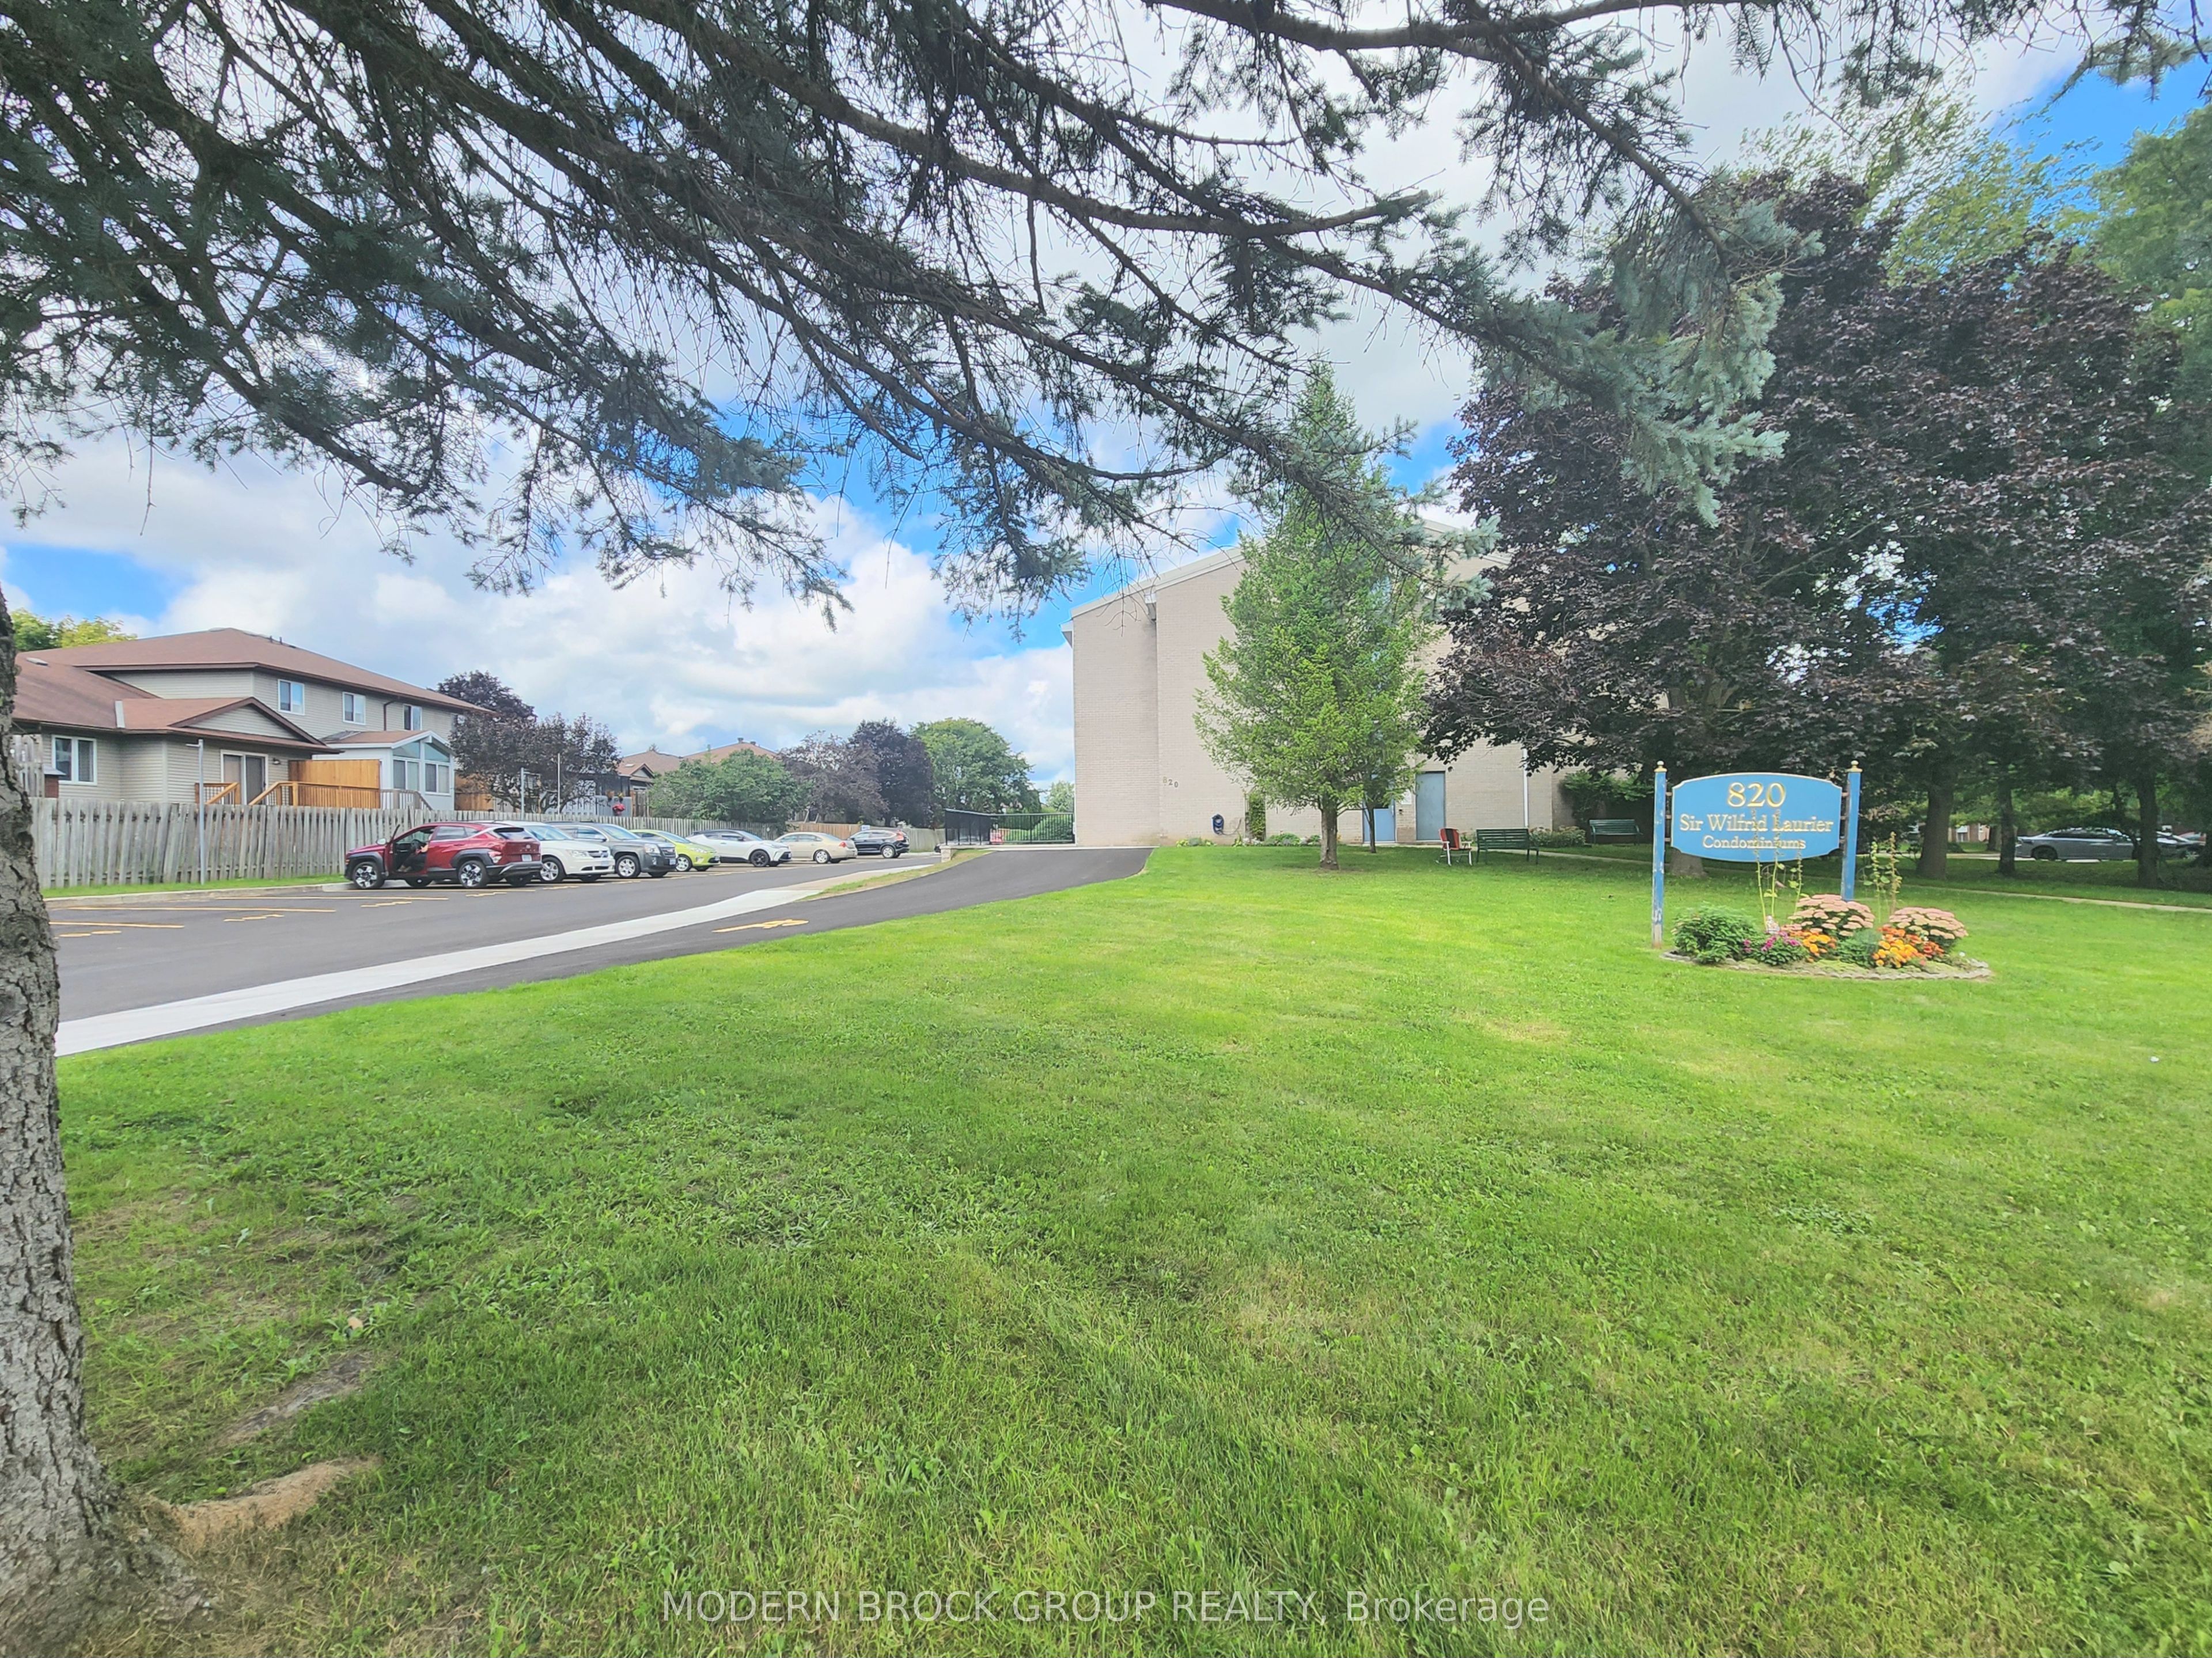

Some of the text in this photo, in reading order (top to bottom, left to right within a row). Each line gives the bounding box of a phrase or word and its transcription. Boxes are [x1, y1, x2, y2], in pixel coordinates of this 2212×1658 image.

[1162, 776, 1179, 788] 820
[1728, 782, 1786, 807] 820
[1679, 813, 1834, 832] Sir Wilfrid Laurier
[1702, 835, 1806, 849] Condominiums
